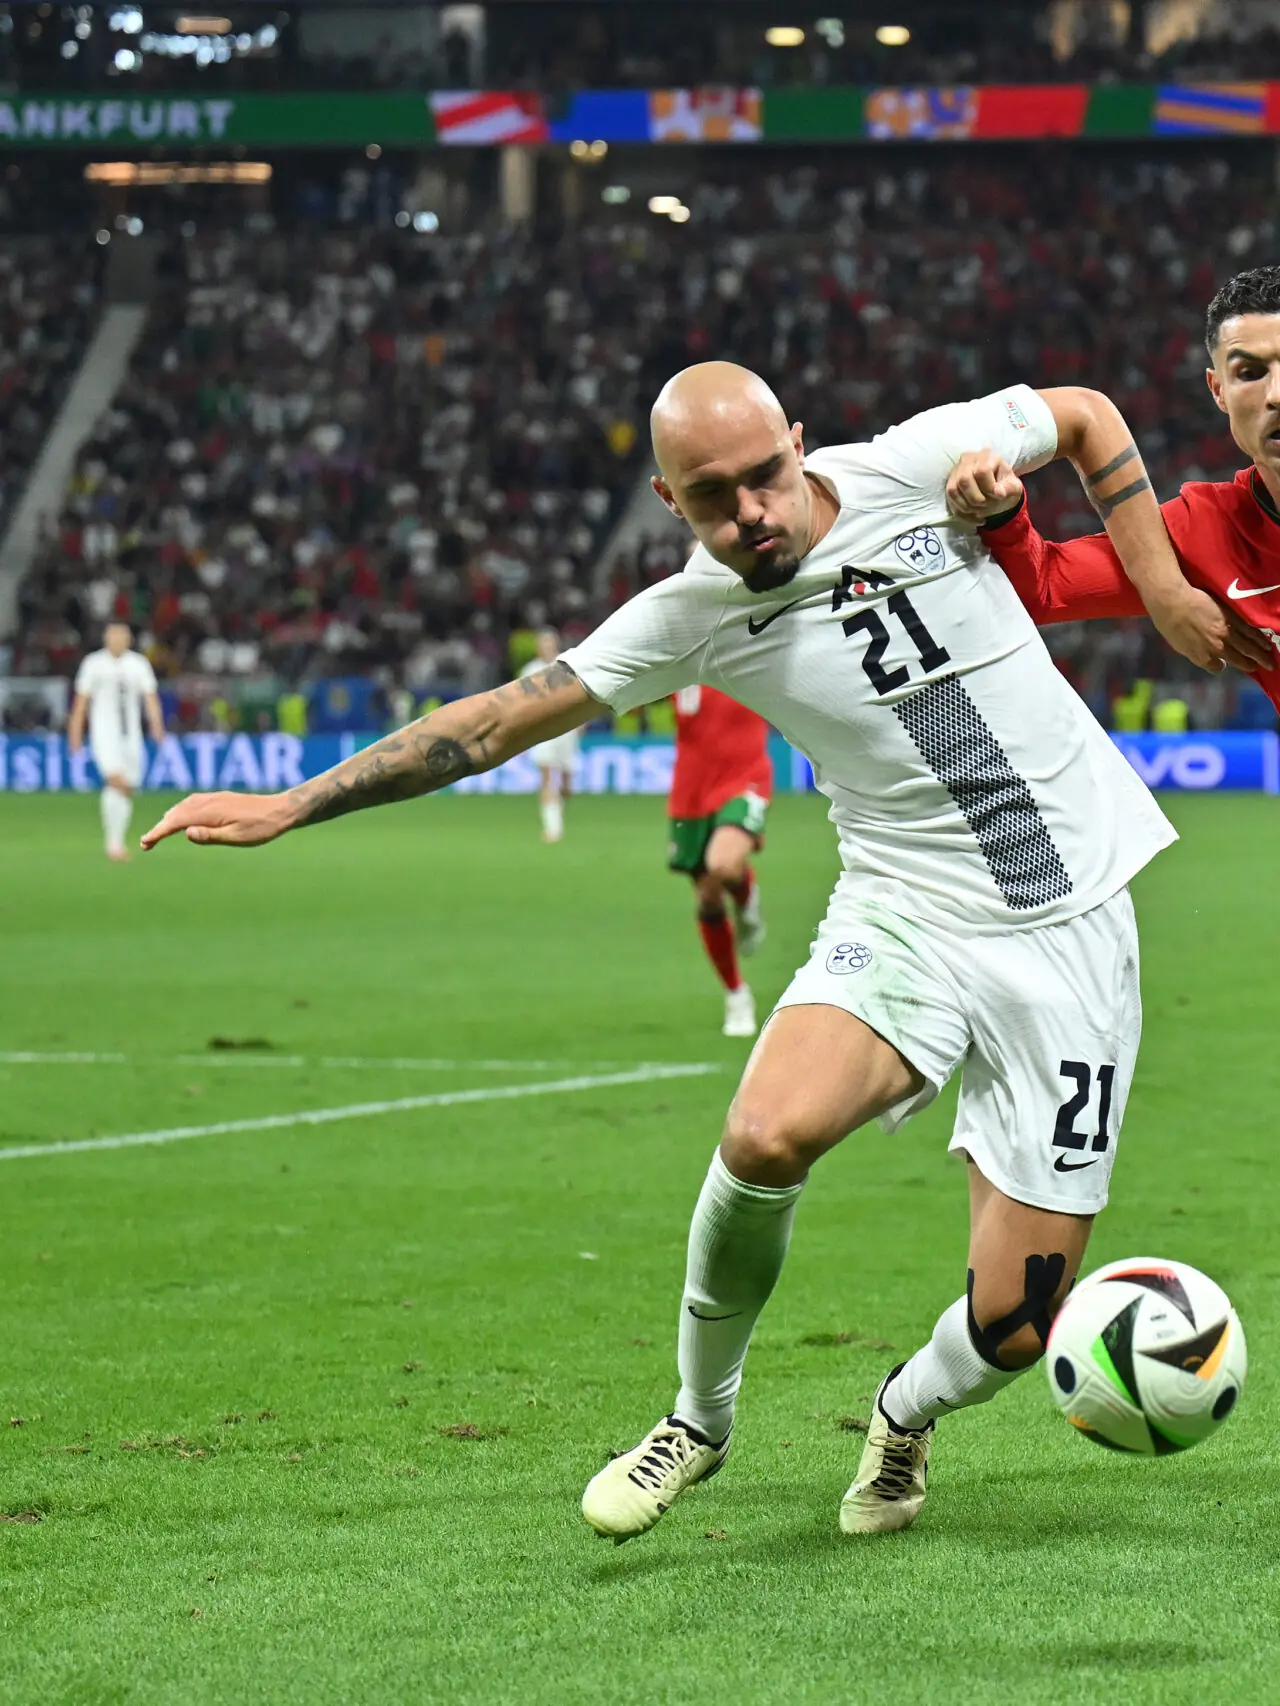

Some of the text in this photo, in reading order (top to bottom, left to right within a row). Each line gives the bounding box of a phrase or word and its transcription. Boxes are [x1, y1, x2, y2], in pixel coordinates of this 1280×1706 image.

[841, 589, 952, 697] 21
[142, 731, 305, 791] ATAR
[1052, 1060, 1116, 1152] 21
